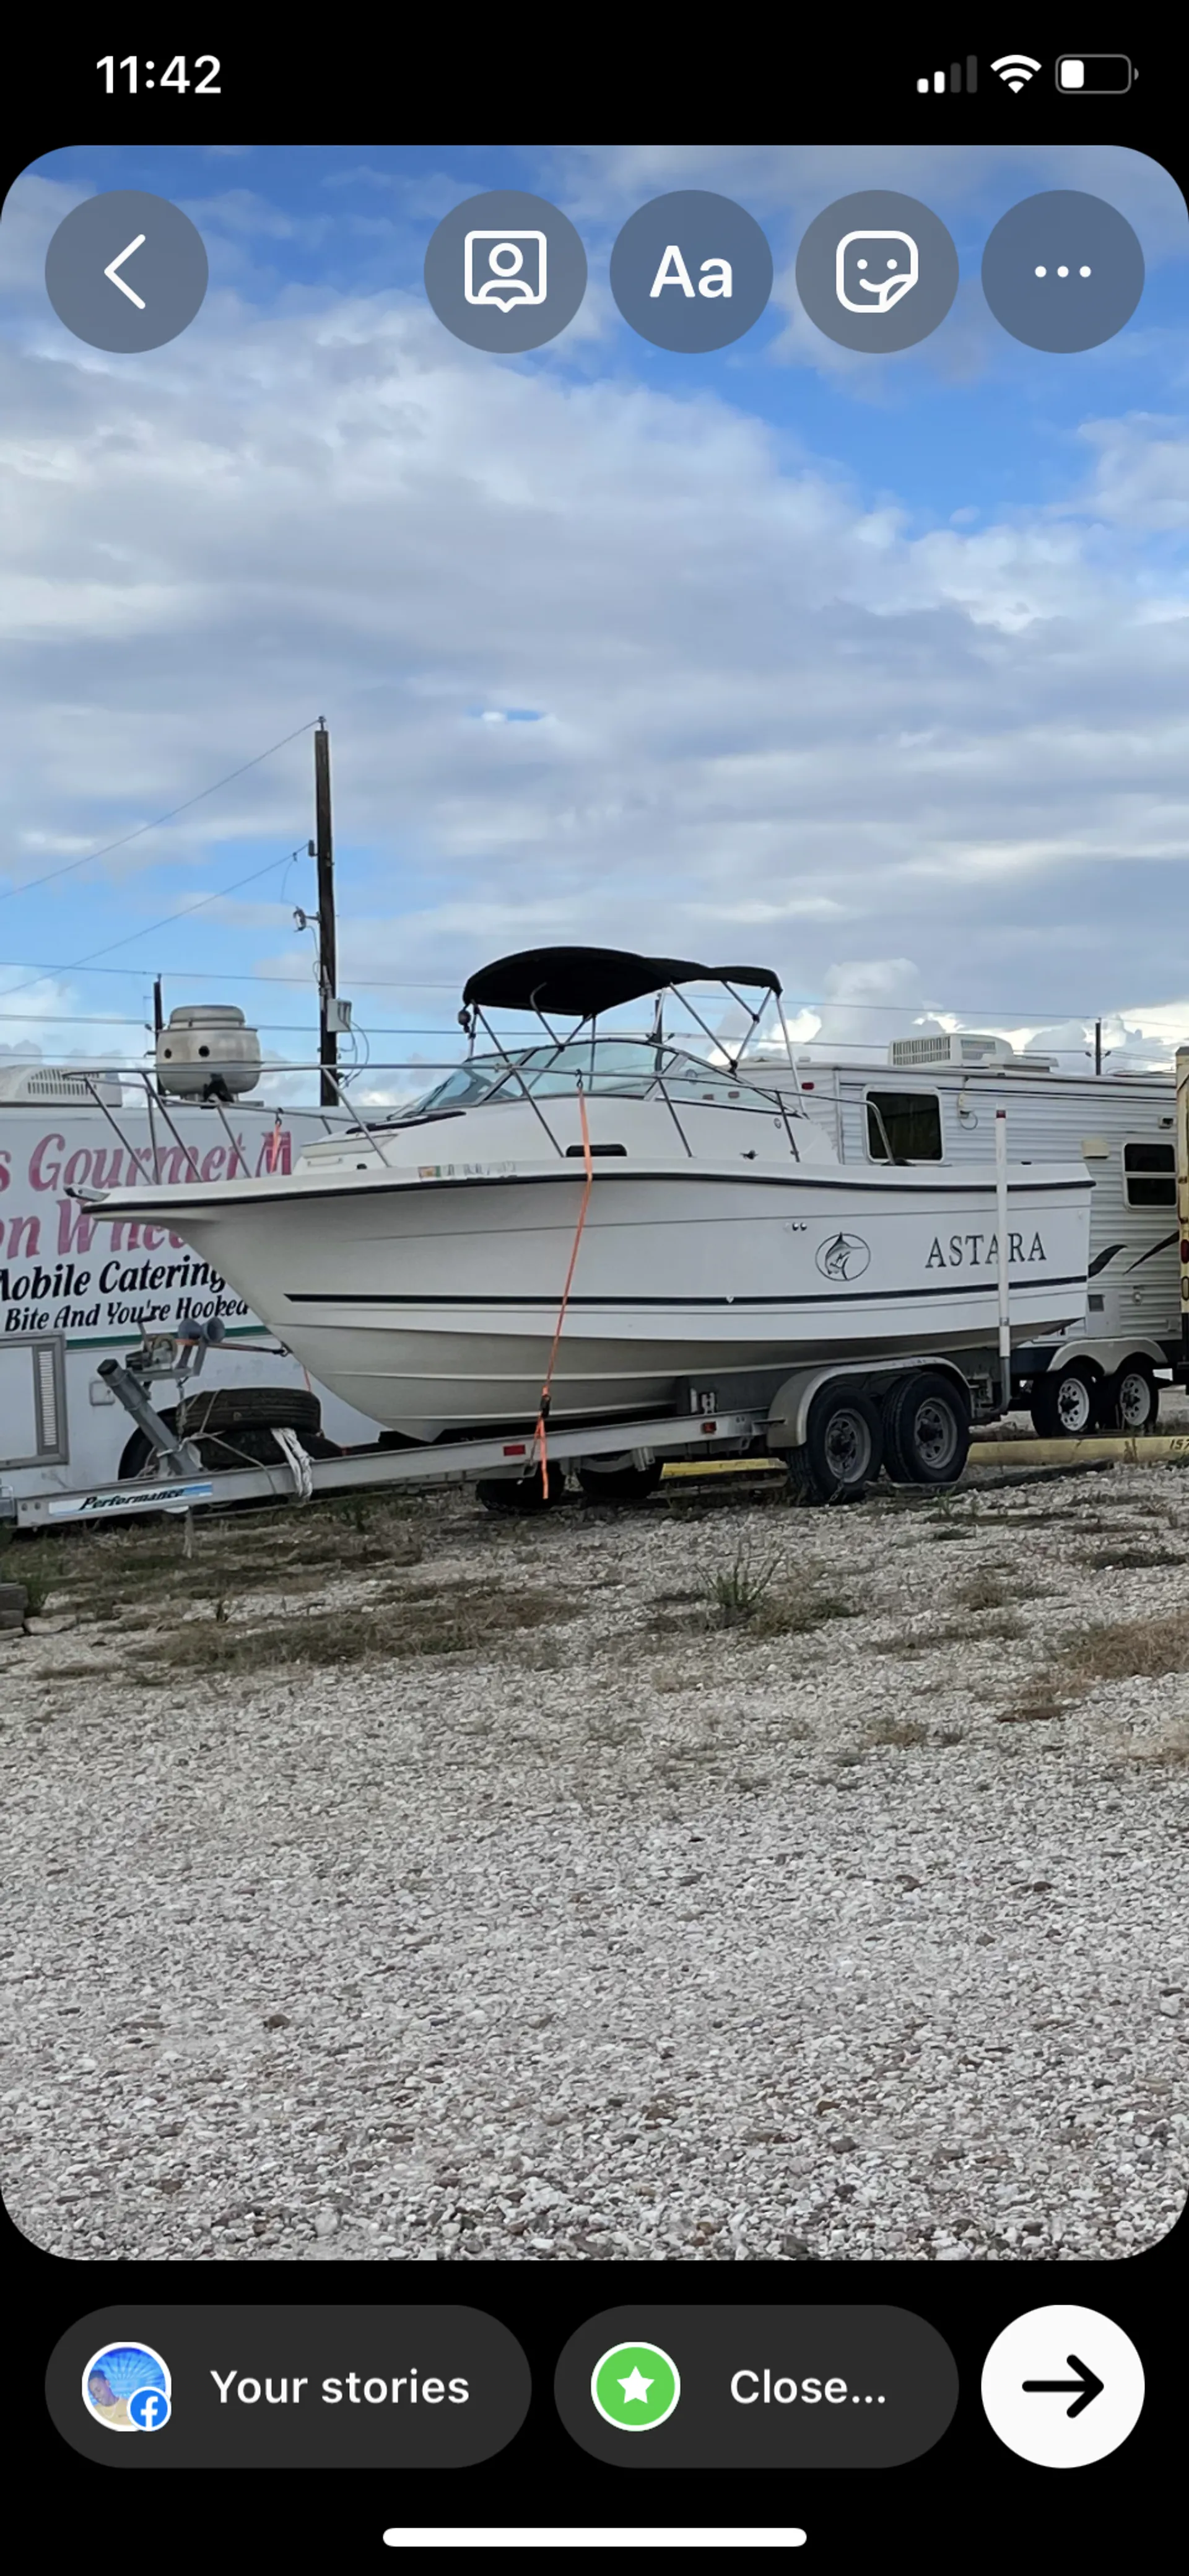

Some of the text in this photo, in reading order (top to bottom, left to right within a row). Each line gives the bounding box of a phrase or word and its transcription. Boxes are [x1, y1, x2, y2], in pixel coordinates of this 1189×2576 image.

[28, 1132, 246, 1192] Gourmet
[925, 1231, 1047, 1268] ASTARA
[99, 1255, 226, 1294] Catering
[5, 1307, 50, 1332] Bite
[54, 1303, 100, 1329] And
[107, 1300, 171, 1325] You're
[78, 1487, 185, 1511] Performance
